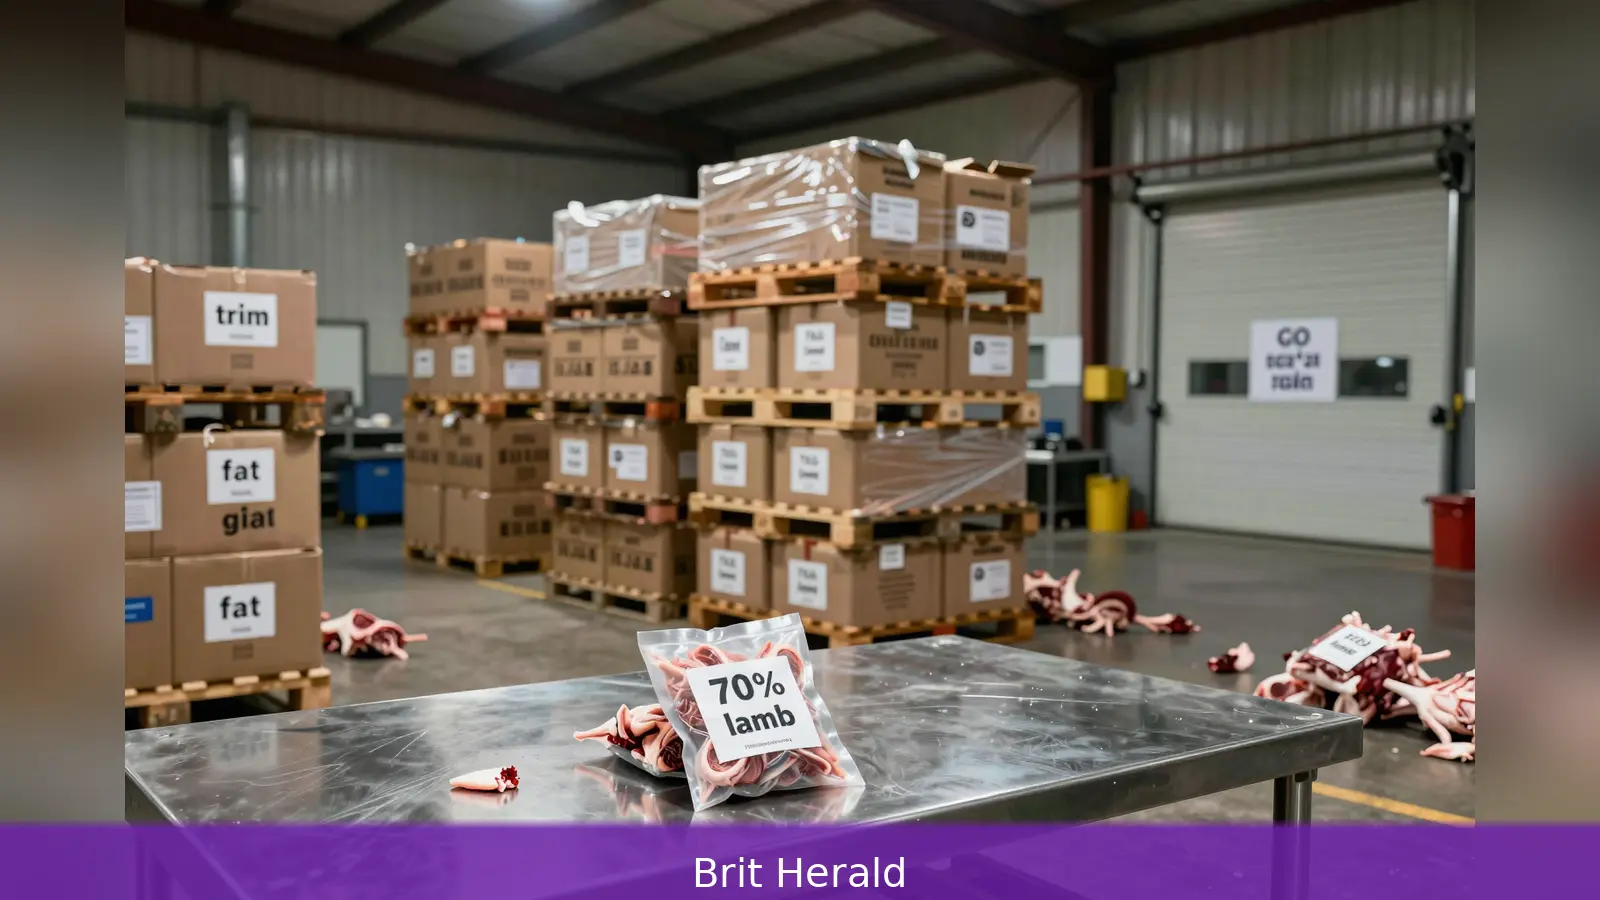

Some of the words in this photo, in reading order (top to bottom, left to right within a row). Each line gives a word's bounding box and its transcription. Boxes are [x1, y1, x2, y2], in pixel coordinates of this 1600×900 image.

[216, 304, 269, 327] trim
[222, 459, 260, 482] fat
[219, 594, 261, 620] fat
[708, 670, 786, 705] 70%
[723, 704, 796, 737] lamb
